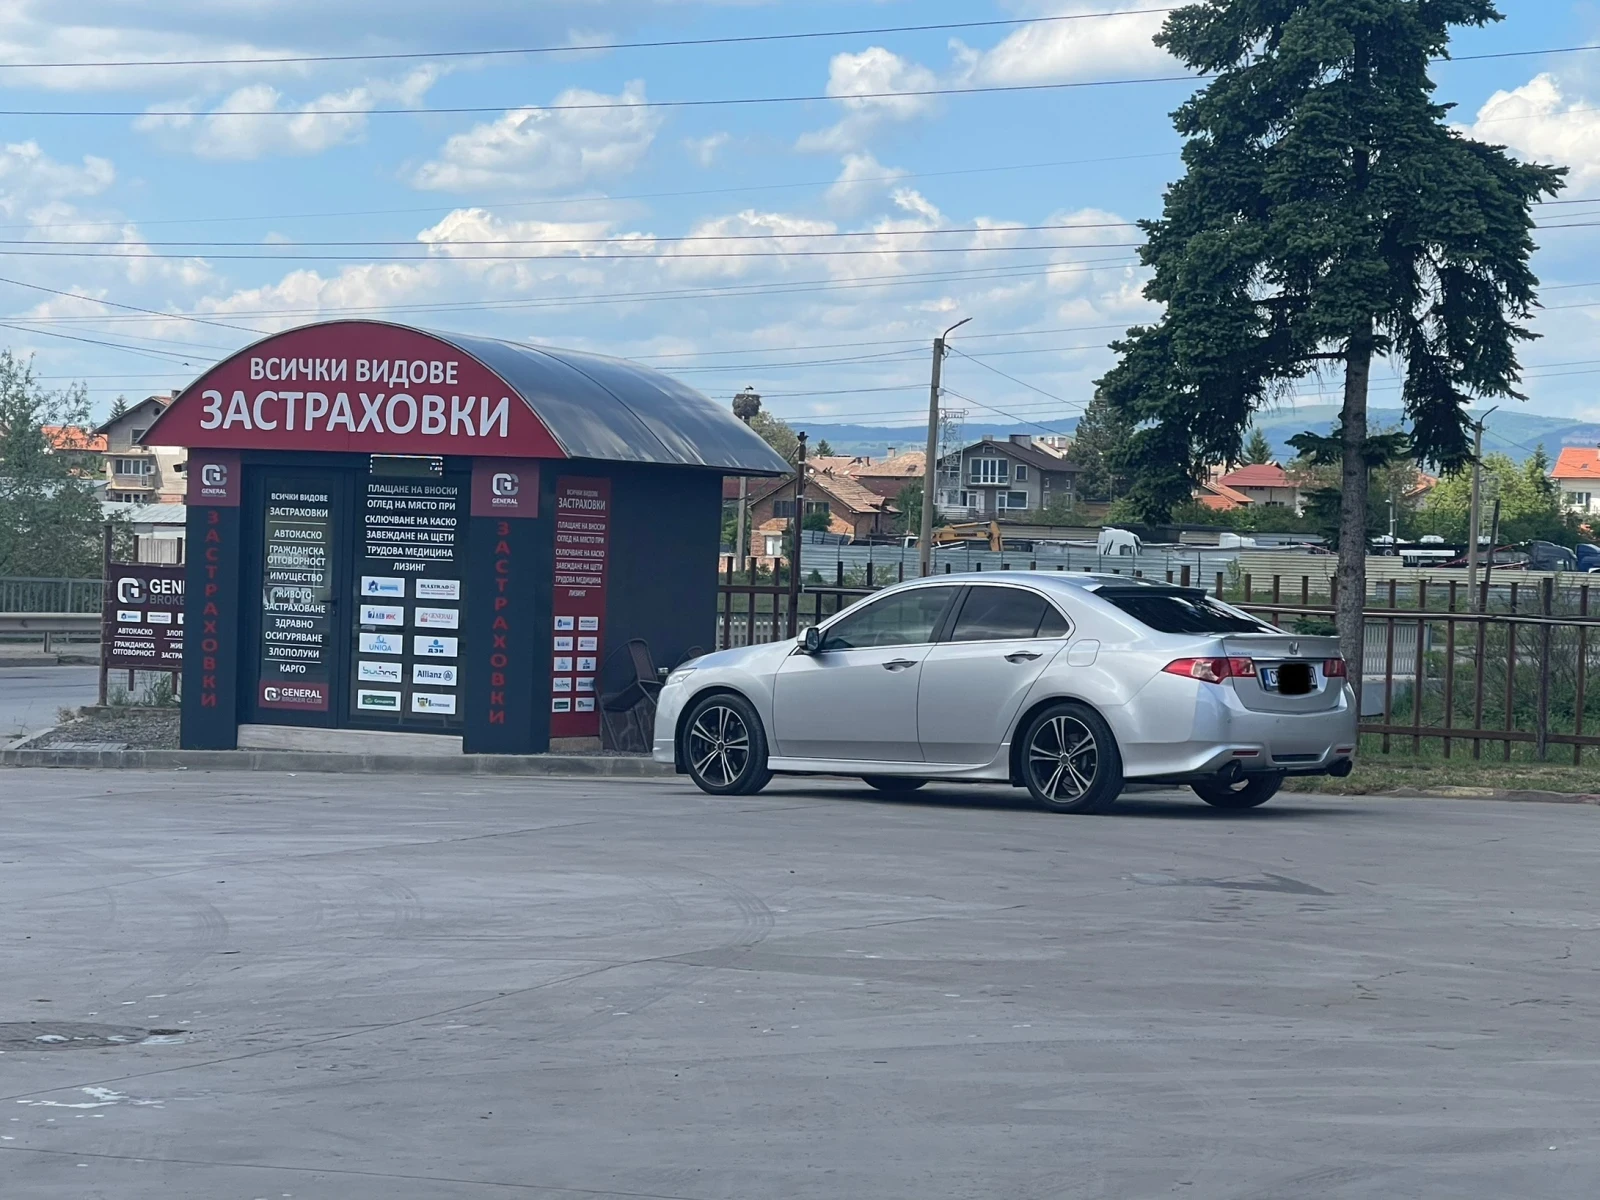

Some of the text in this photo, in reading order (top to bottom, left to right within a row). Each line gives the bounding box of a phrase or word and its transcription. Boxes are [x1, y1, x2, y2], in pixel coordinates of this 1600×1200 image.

[250, 356, 459, 388] ВСИЧКИ ВИДОВЕ
[200, 389, 510, 438] ЗАСТРАХОВКИ
[368, 484, 458, 496] ПЛАЩАНЕ НА ВНОСКИ
[271, 492, 328, 502] ВСИЧКИ ВИДОВЕ
[367, 500, 456, 511] ОГЛЕД НА МЯСТО ПРИ
[558, 498, 606, 510] ЗАСТРАХОВКИ
[270, 506, 328, 518] ЗАСТРАХОВКИ
[365, 514, 457, 526] СКЛЮЧВАНЕ НА КАСКО
[558, 521, 581, 530] ПЛАЩАНЕ
[274, 530, 322, 539] АВТОКАСКО
[366, 530, 454, 543] ЗАВЕЖДАНЕ НА ЩЕТИ
[557, 535, 572, 544] ОГЛЕД
[269, 545, 324, 556] ГРАЖДАНСКА
[367, 546, 453, 558] ТРУДОВА МЕДИЦИНА
[556, 548, 583, 556] СКЛЮЧВАНЕ
[267, 556, 326, 566] ОТГОВОРНОСТ
[556, 562, 582, 570] ЗАВЕЖДАНЕ
[393, 562, 426, 572] ЛИЗИНГ
[270, 572, 323, 582] ИМУЩЕСТВО
[555, 576, 575, 584] ТРУДОВА
[276, 590, 315, 598] ЖИВОТО-
[201, 510, 220, 707] ЗАСТРАХОВКИ
[264, 602, 326, 613] ЗАСТРАХОВАНЕ
[275, 618, 314, 629] ЗДРАВНО
[489, 522, 510, 724] ЗАСТРАХОВКИ
[117, 627, 153, 635] АВТОКАСКО
[265, 631, 322, 642] ОСИГУРЯВАНЕ
[114, 641, 155, 649] ГРАЖДАНСКА
[112, 649, 155, 657] ОТГОВОРНОСТ
[269, 647, 319, 658] ЗЛОПОЛУКИ
[280, 664, 306, 673] КАРГО
[417, 670, 442, 678] Allianz
[282, 688, 322, 698] GENERAL
